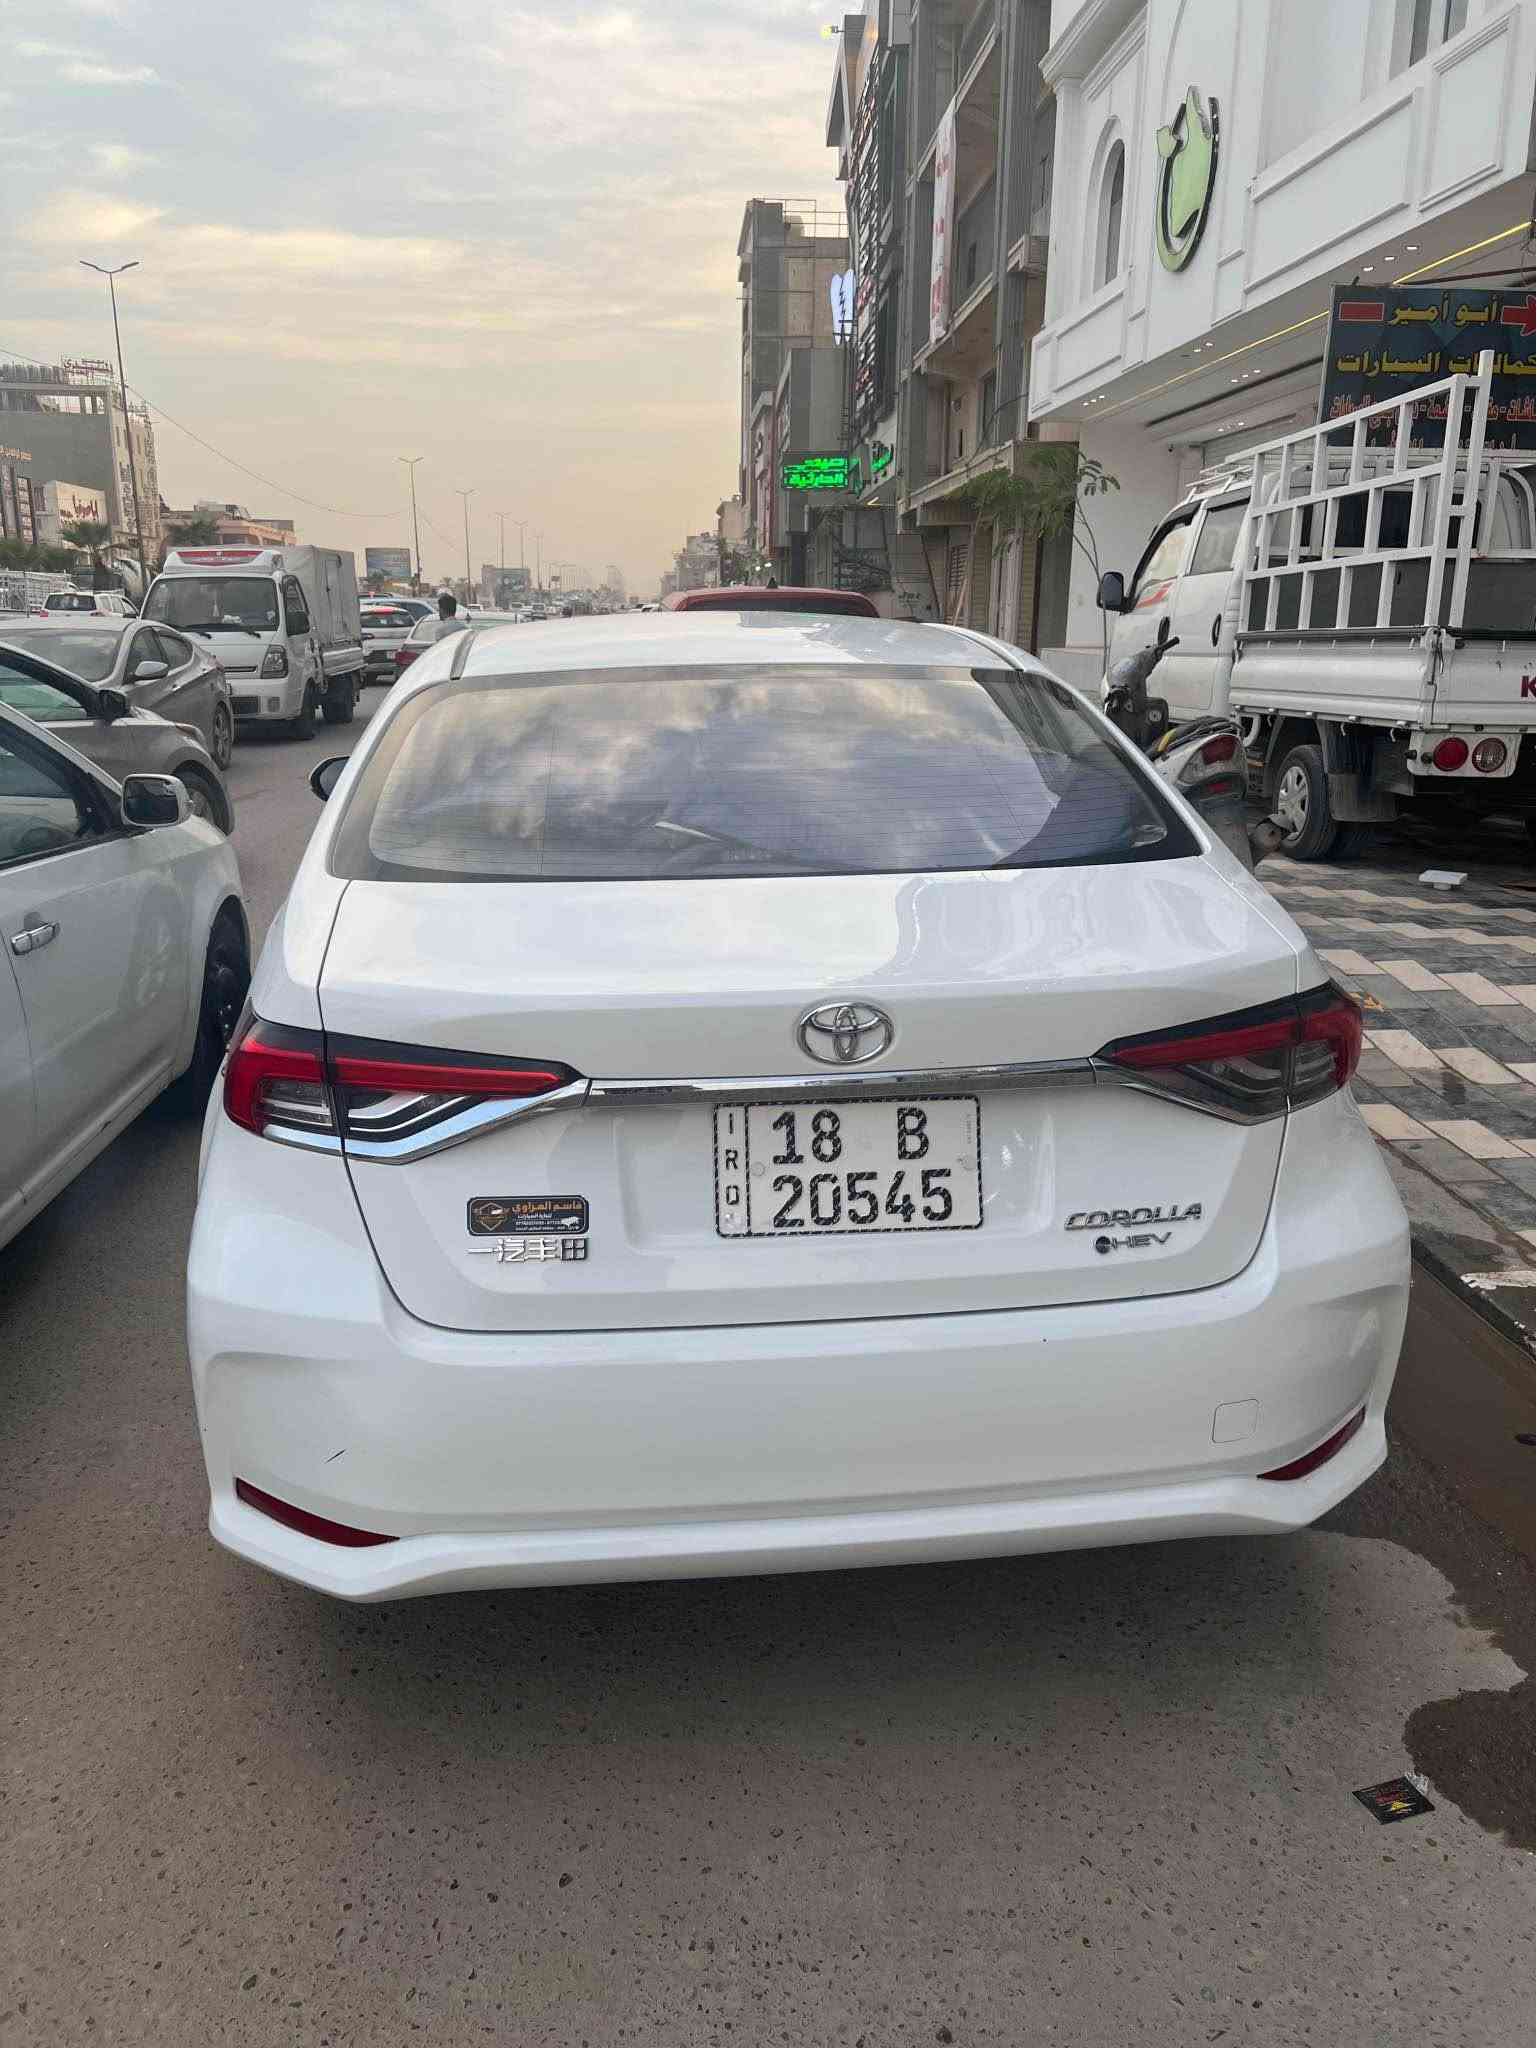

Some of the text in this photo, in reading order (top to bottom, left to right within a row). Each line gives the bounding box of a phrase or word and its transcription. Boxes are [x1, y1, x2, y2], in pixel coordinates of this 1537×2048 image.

[772, 1108, 842, 1164] 18
[897, 1107, 929, 1160] B
[772, 1168, 952, 1228] 20545
[1065, 1201, 1202, 1231] COROLLA
[467, 1238, 588, 1264] 一汽丰田
